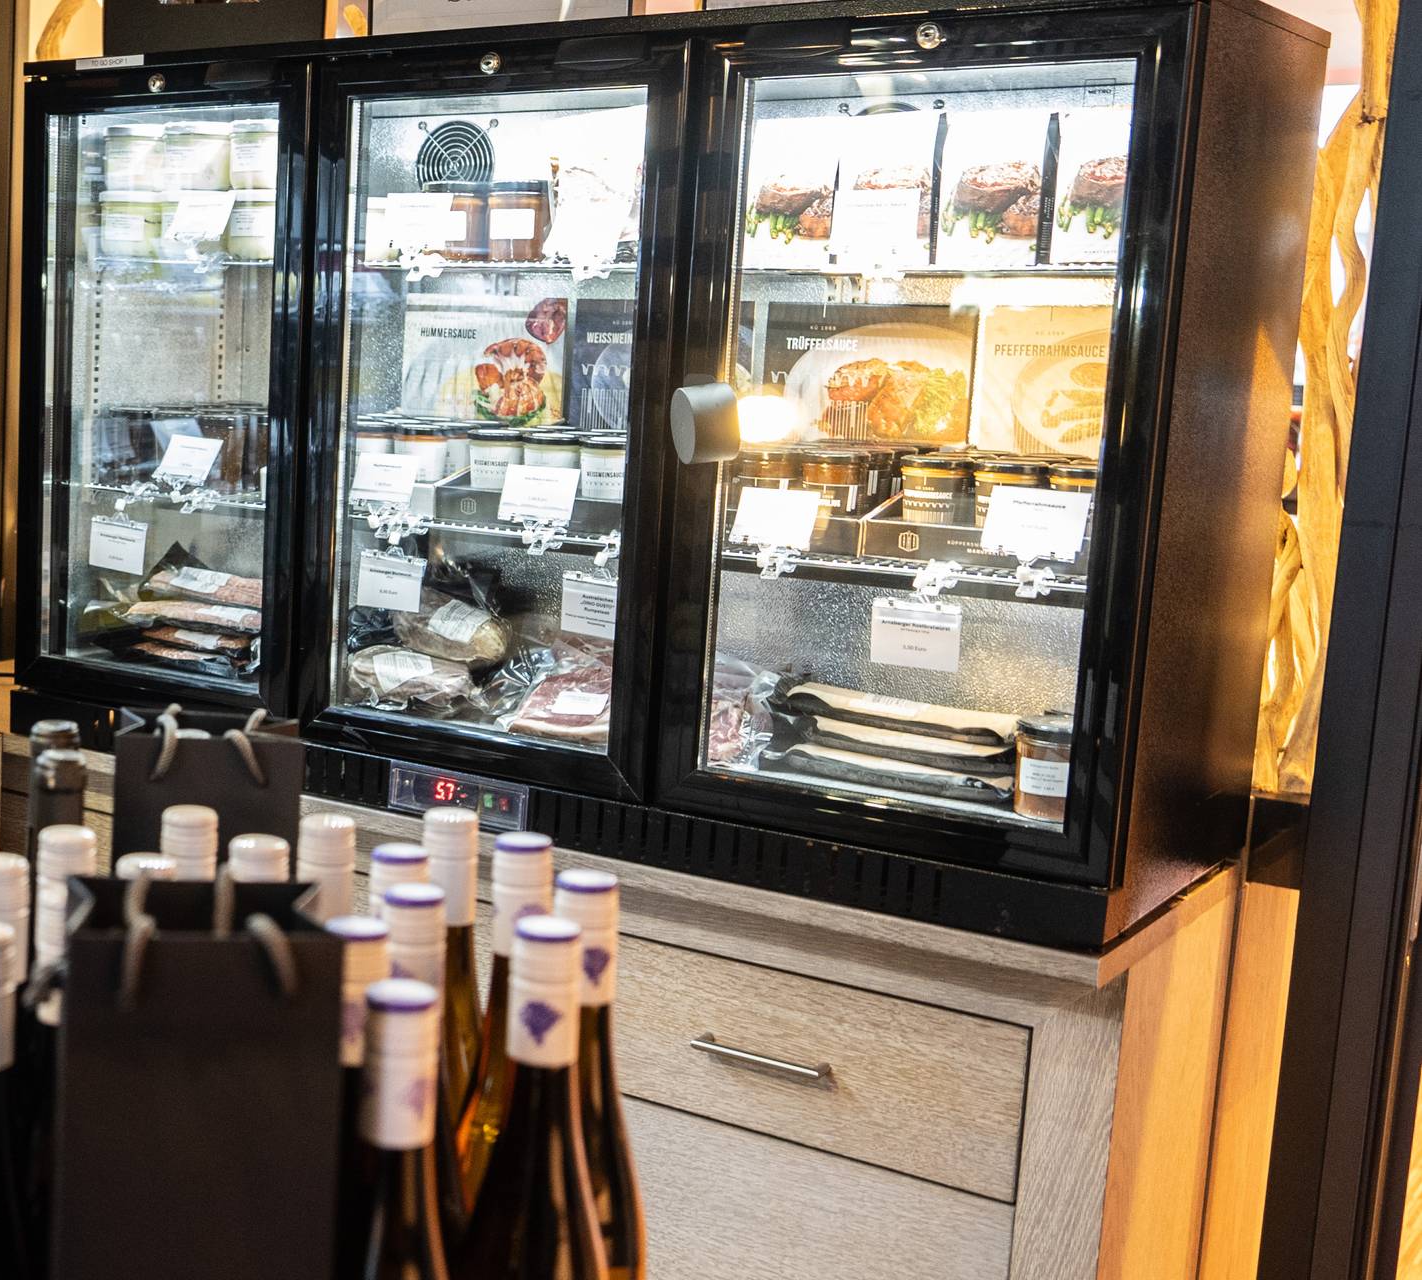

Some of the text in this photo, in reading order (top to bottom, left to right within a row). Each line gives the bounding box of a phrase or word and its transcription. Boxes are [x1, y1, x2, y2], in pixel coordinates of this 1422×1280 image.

[420, 327, 477, 340] HUMMERSAUCE
[786, 336, 858, 352] TRÜFFELSAUCE
[994, 344, 1106, 358] PFEFFERRAHMSAUCE
